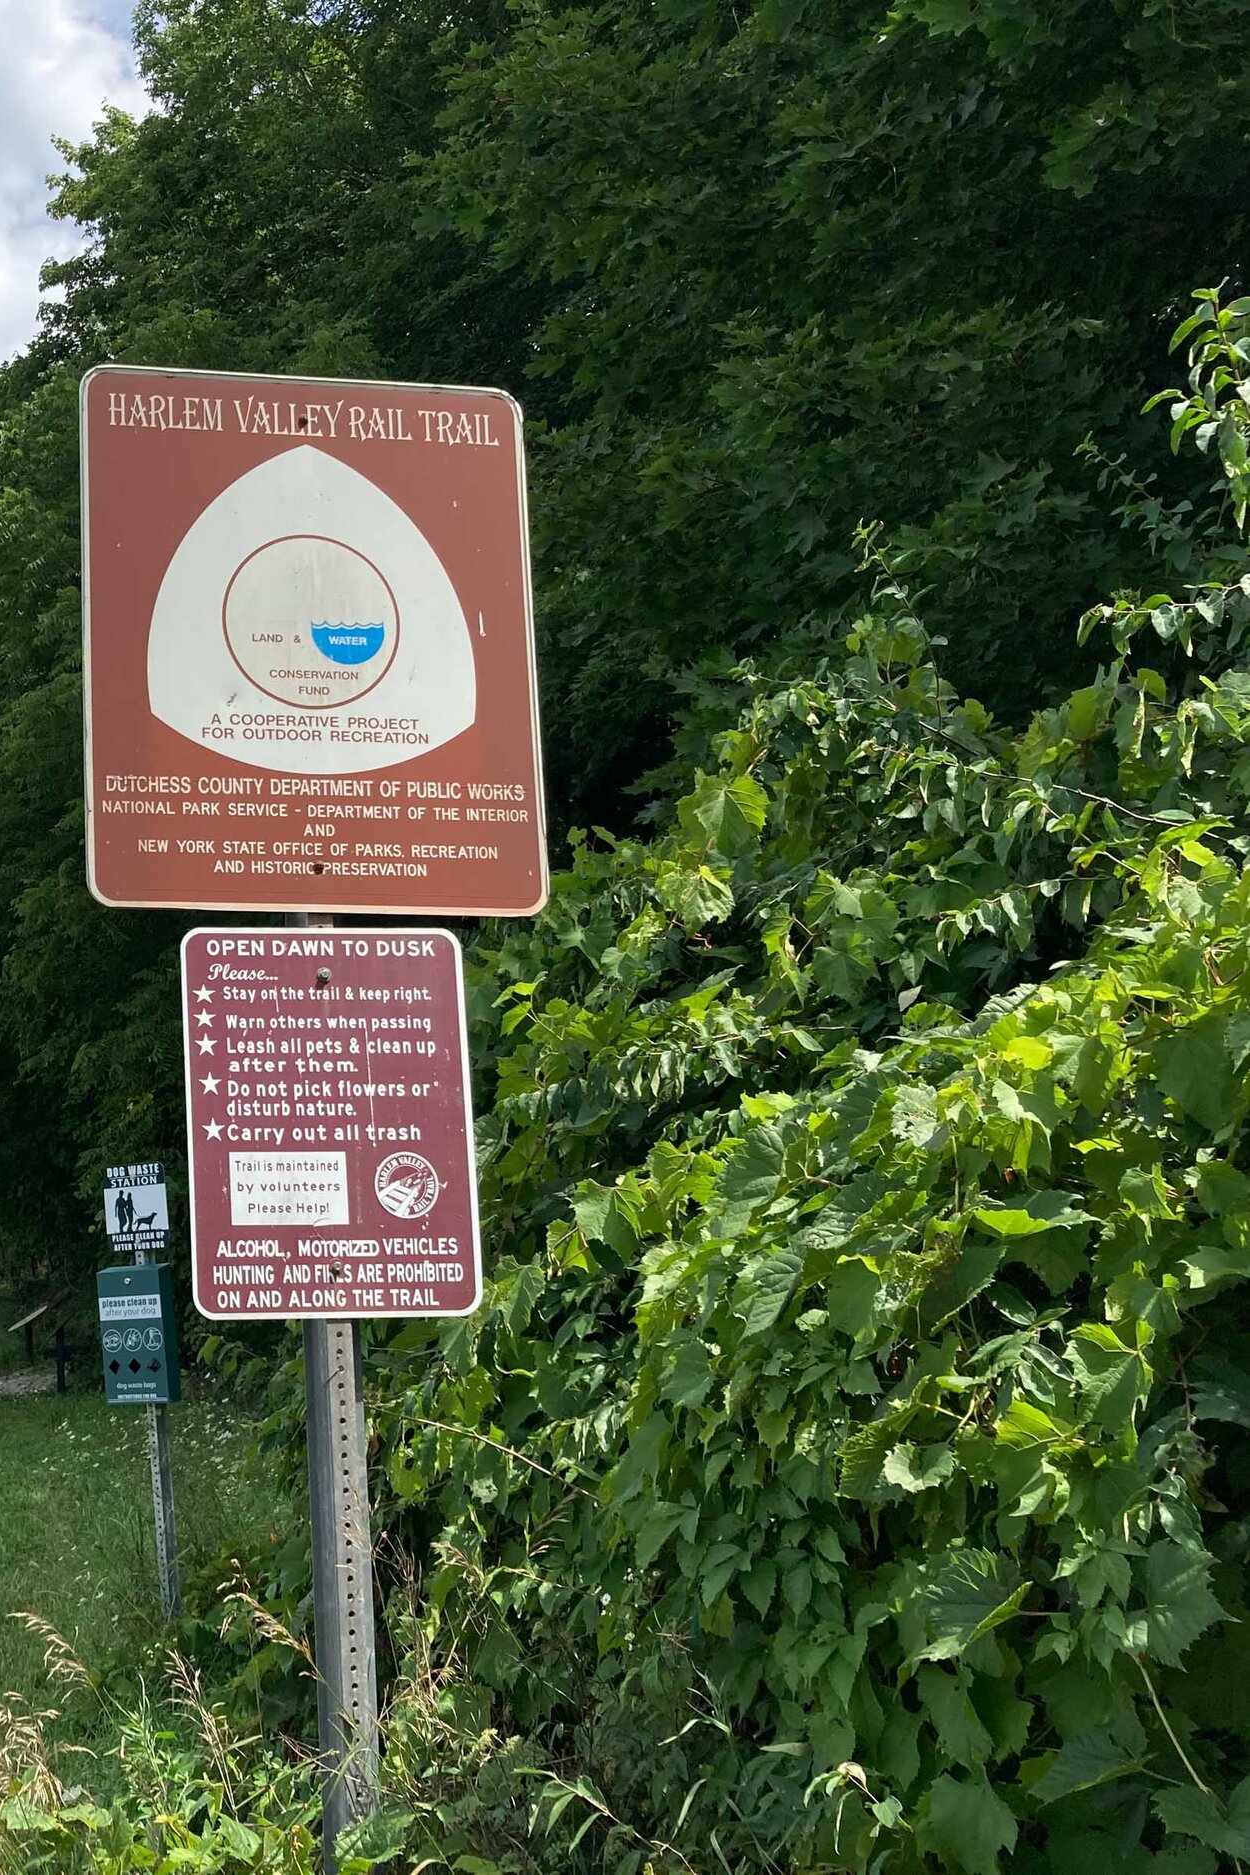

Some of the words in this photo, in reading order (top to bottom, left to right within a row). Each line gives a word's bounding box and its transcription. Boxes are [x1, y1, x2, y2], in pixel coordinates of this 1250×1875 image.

[109, 393, 223, 432] HARLEM
[234, 396, 344, 438] VALLEY
[349, 406, 412, 441] RAIL
[418, 410, 499, 446] TRAIL
[252, 633, 283, 643] LAND
[294, 635, 301, 643] &
[328, 635, 368, 646] WATER
[269, 669, 359, 681] CONSERVATION
[299, 686, 330, 696] FUND
[211, 714, 222, 725] A
[230, 713, 340, 728] COOPERATIVE
[348, 717, 419, 730] PROJECT
[202, 727, 234, 739] FOR
[243, 728, 322, 742] OUTDOOR
[330, 730, 429, 745] RECREATION
[106, 775, 191, 794] DUTCHESS
[198, 778, 264, 795] COUNTY
[270, 779, 373, 797] DEPARTMENT
[380, 781, 401, 798] OF
[407, 781, 461, 799] PUBLIC
[467, 783, 526, 801] WORKS
[102, 800, 176, 815] NATIONAL
[182, 802, 220, 816] PARK
[228, 803, 288, 817] SERVICE
[308, 804, 401, 819] DEPARTMENT
[408, 806, 426, 820] OF
[433, 807, 460, 821] THE
[466, 808, 529, 823] INTERIOR
[304, 824, 335, 837] AND
[138, 839, 169, 853] NEW
[177, 840, 215, 854] YORK
[223, 841, 266, 855] STATE
[273, 842, 323, 856] OFFICE
[330, 843, 348, 856] OF
[411, 845, 498, 860] RECREATION
[214, 860, 245, 874] AND
[251, 860, 314, 875] HISTORIC
[323, 862, 428, 877] PRESERVATION
[206, 939, 265, 957] OPEN
[272, 940, 334, 957] DAWN
[342, 940, 368, 957] TO
[376, 940, 435, 957] DUSK
[207, 963, 279, 982] Please...
[223, 986, 256, 1003] Stay
[261, 989, 276, 1000] on
[281, 986, 304, 1000] the
[308, 986, 340, 1000] trail
[345, 987, 354, 1000] &
[359, 987, 391, 1003] keep
[394, 987, 432, 1004] right.
[226, 1014, 265, 1029] Warn
[270, 1014, 321, 1029] others
[326, 1015, 366, 1029] when
[371, 1015, 431, 1032] passing
[227, 1038, 275, 1054] Leash
[280, 1038, 300, 1054] all
[306, 1039, 342, 1057] pets
[349, 1038, 360, 1054] &
[367, 1038, 413, 1054] clean
[416, 1040, 436, 1057] up
[229, 1058, 286, 1072] after
[295, 1058, 358, 1073] them.
[227, 1080, 250, 1096] Do
[256, 1081, 287, 1096] not
[293, 1080, 332, 1100] pick
[338, 1080, 406, 1096] flowers
[411, 1083, 430, 1096] or
[227, 1100, 290, 1116] disturb
[295, 1100, 356, 1116] nature.
[227, 1124, 284, 1144] Carry
[292, 1125, 327, 1140] out
[334, 1124, 359, 1140] all
[365, 1124, 421, 1141] trash
[106, 1166, 125, 1178] DOG
[128, 1163, 159, 1176] WASTE
[235, 1160, 260, 1172] Trail
[263, 1160, 273, 1172] is
[276, 1160, 339, 1172] maintained
[378, 1159, 399, 1188] HARLEM
[398, 1156, 426, 1170] VALLEY
[111, 1176, 157, 1188] STATION
[237, 1181, 254, 1194] by
[260, 1181, 341, 1192] volunteers
[412, 1199, 430, 1213] RAIL
[425, 1175, 435, 1199] TRAIL
[248, 1203, 291, 1214] Please
[296, 1202, 330, 1215] Help!
[111, 1233, 134, 1242] PLEASE
[135, 1231, 155, 1240] CLEAN
[155, 1231, 164, 1239] UP
[114, 1243, 132, 1251] AFTER
[216, 1239, 291, 1259] ALCOHOL,
[298, 1239, 379, 1257] MOTORIZED
[382, 1238, 458, 1255] VEHICLES
[213, 1265, 274, 1285] HUNTING
[283, 1264, 310, 1284] AND
[357, 1263, 384, 1283] ARE
[387, 1262, 464, 1283] PROHIBITED
[102, 1299, 125, 1308] please
[127, 1298, 146, 1306] clean
[148, 1298, 157, 1306] up
[217, 1290, 240, 1309] ON
[247, 1290, 282, 1308] AND
[289, 1289, 347, 1307] ALONG
[352, 1289, 384, 1306] THE
[390, 1289, 440, 1306] TRAIL
[106, 1308, 121, 1316] after
[123, 1309, 139, 1317] your
[141, 1307, 156, 1316] dog
[116, 1382, 127, 1390] dog
[143, 1381, 156, 1389] bags
